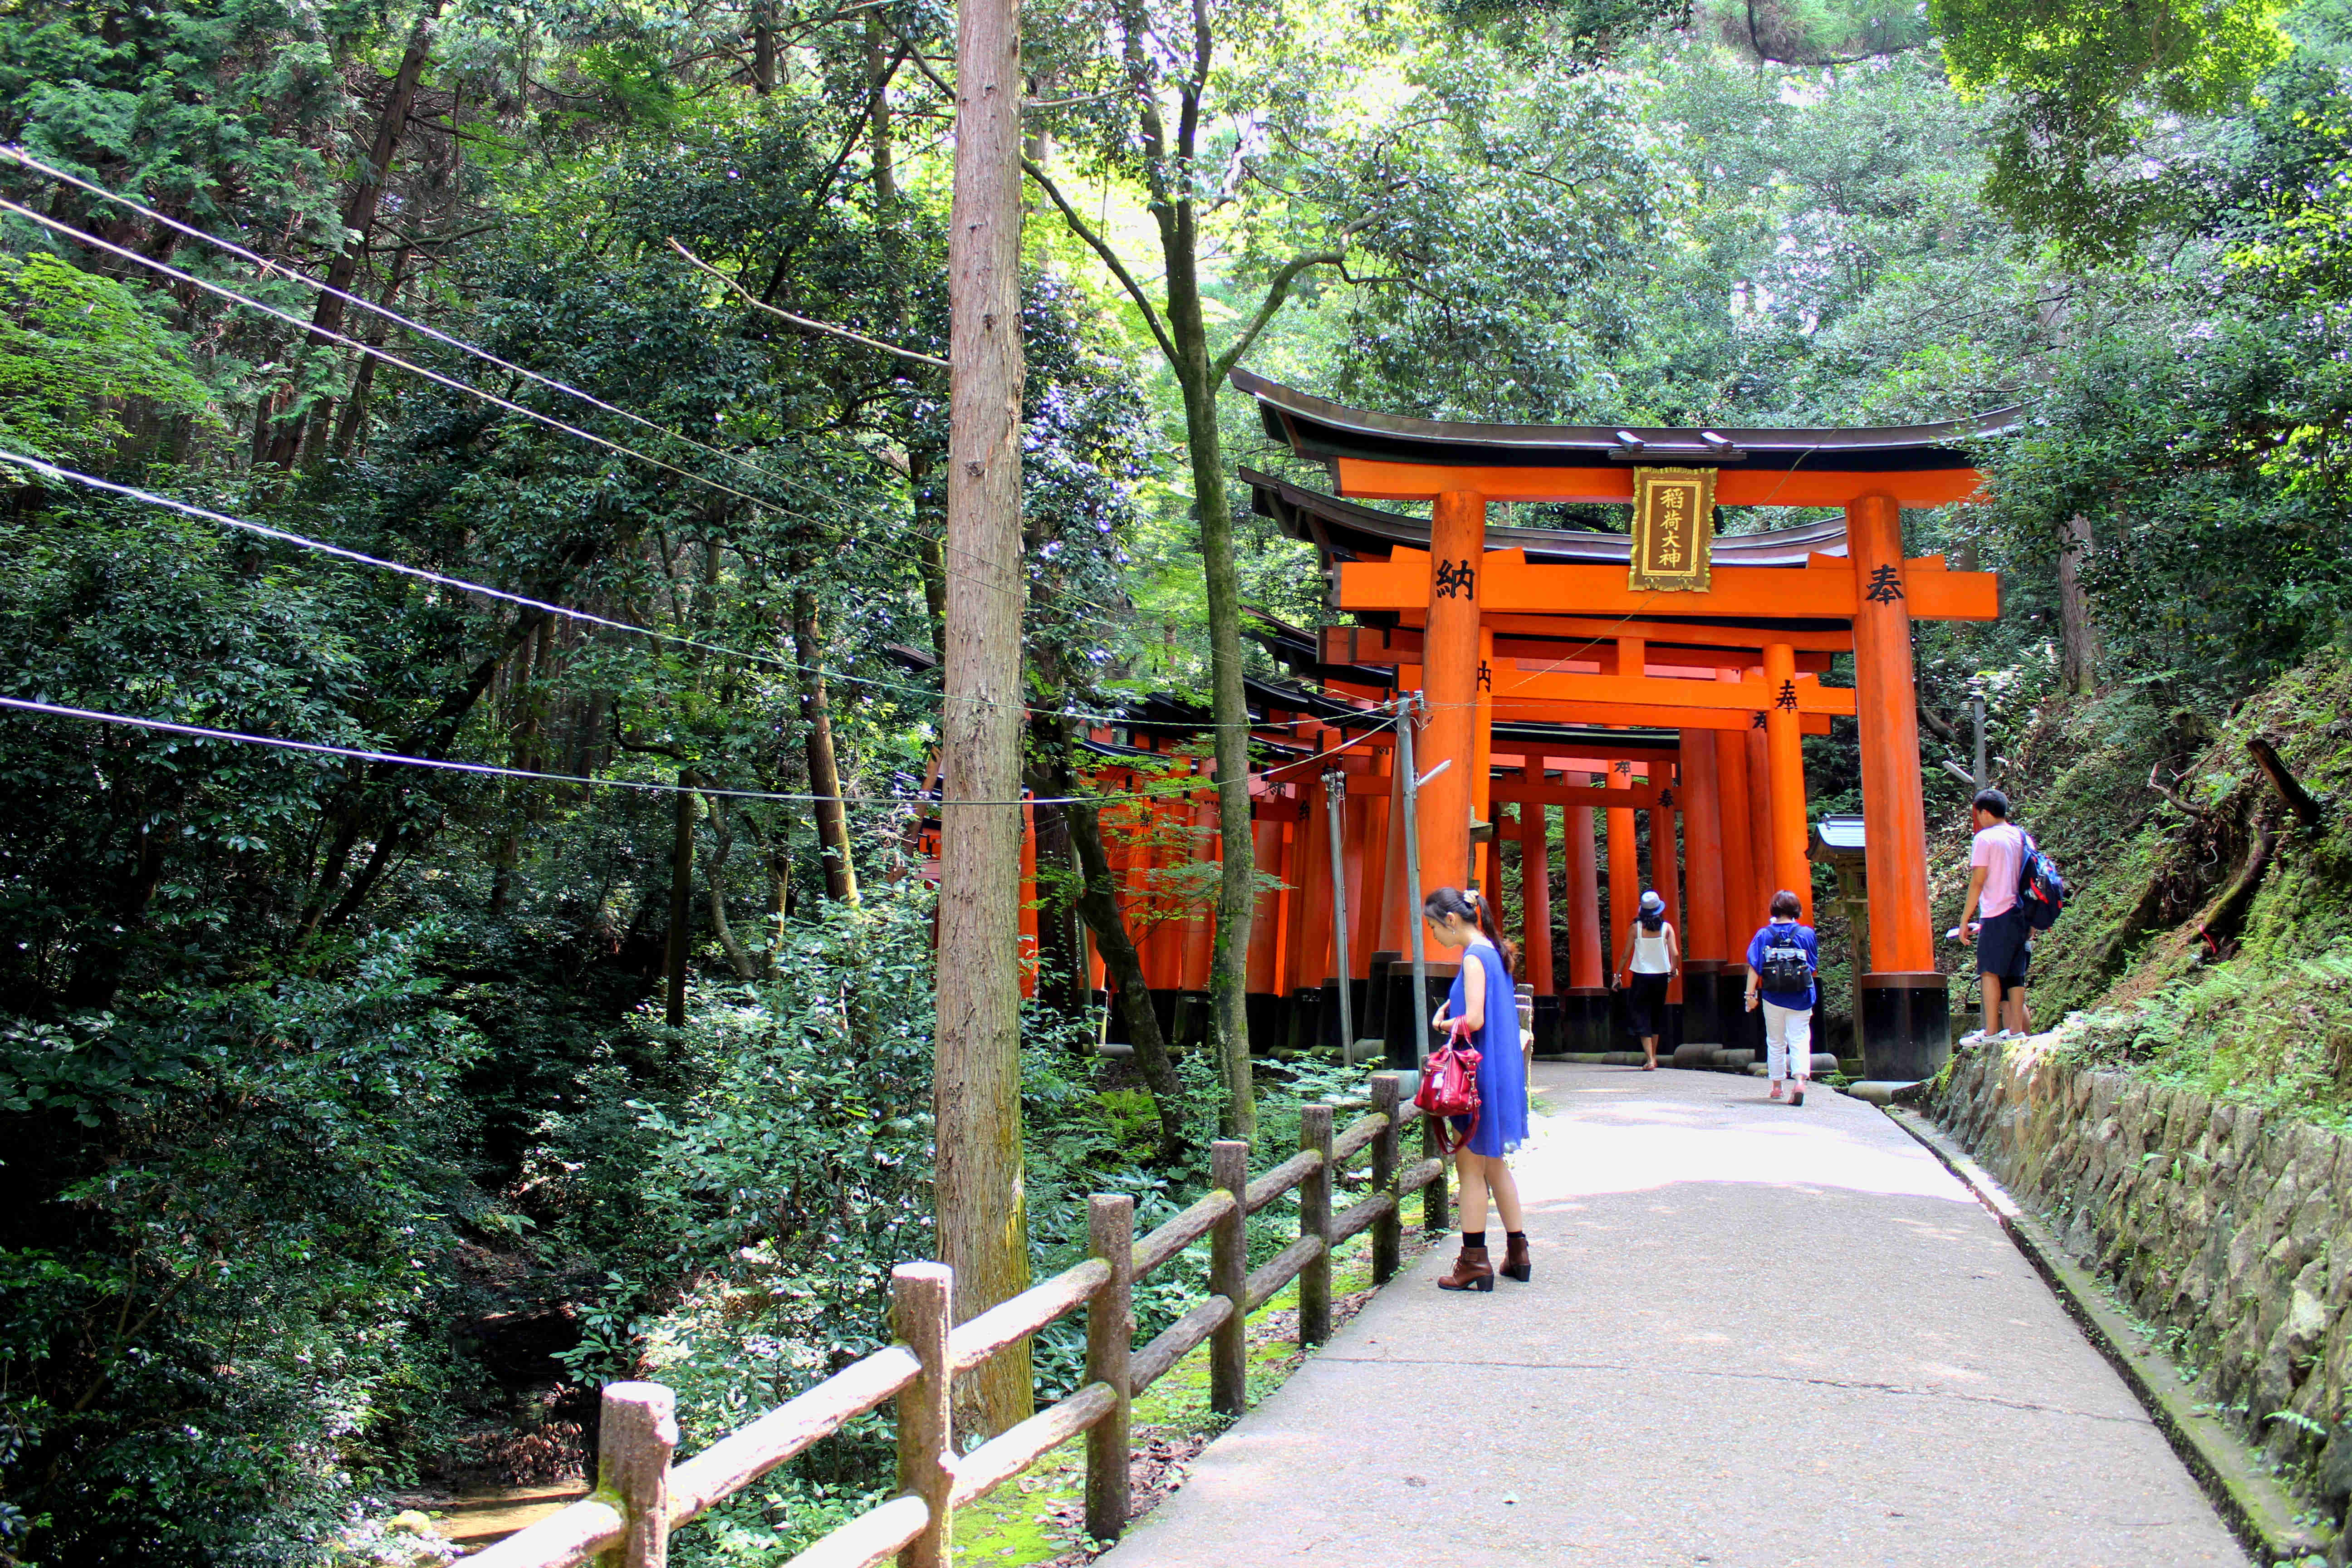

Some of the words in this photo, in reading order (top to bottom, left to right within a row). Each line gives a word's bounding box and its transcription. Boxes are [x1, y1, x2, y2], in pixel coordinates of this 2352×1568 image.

[1658, 487, 1685, 568] 稲荷大神
[1436, 559, 1475, 601] 納
[1865, 564, 1905, 607] 奉
[1774, 679, 1798, 715] 奉
